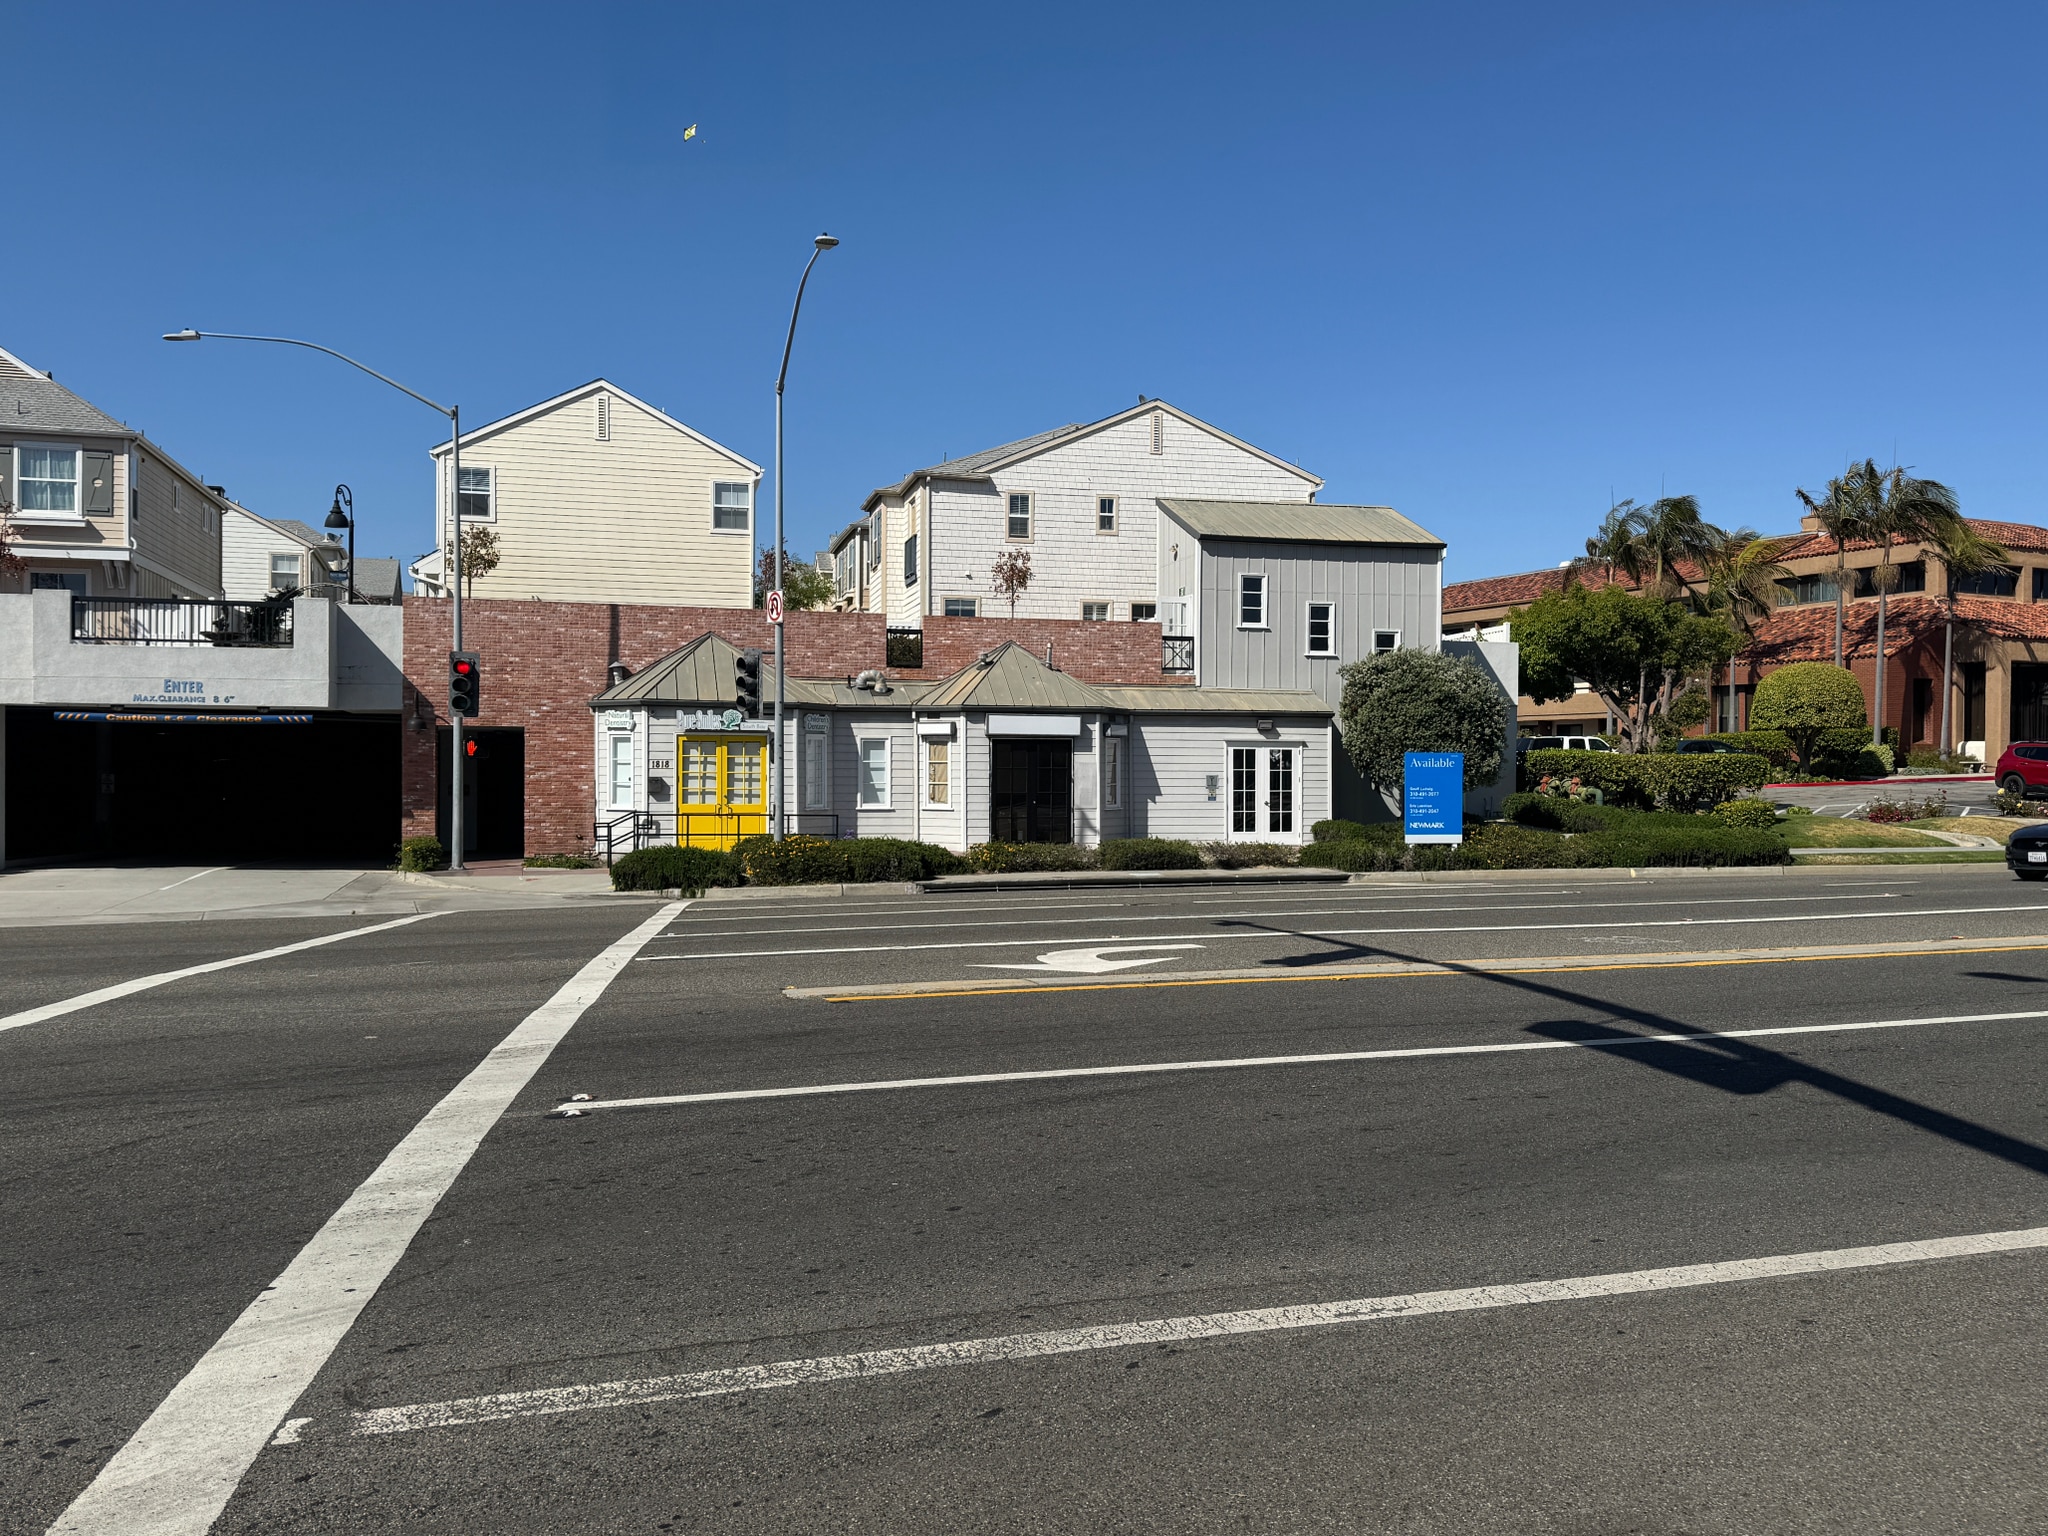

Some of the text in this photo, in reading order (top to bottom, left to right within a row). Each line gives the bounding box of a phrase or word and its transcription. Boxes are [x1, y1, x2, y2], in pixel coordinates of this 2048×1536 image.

[164, 679, 204, 694] ENTER
[652, 760, 670, 768] 1818
[1410, 758, 1455, 768] Available
